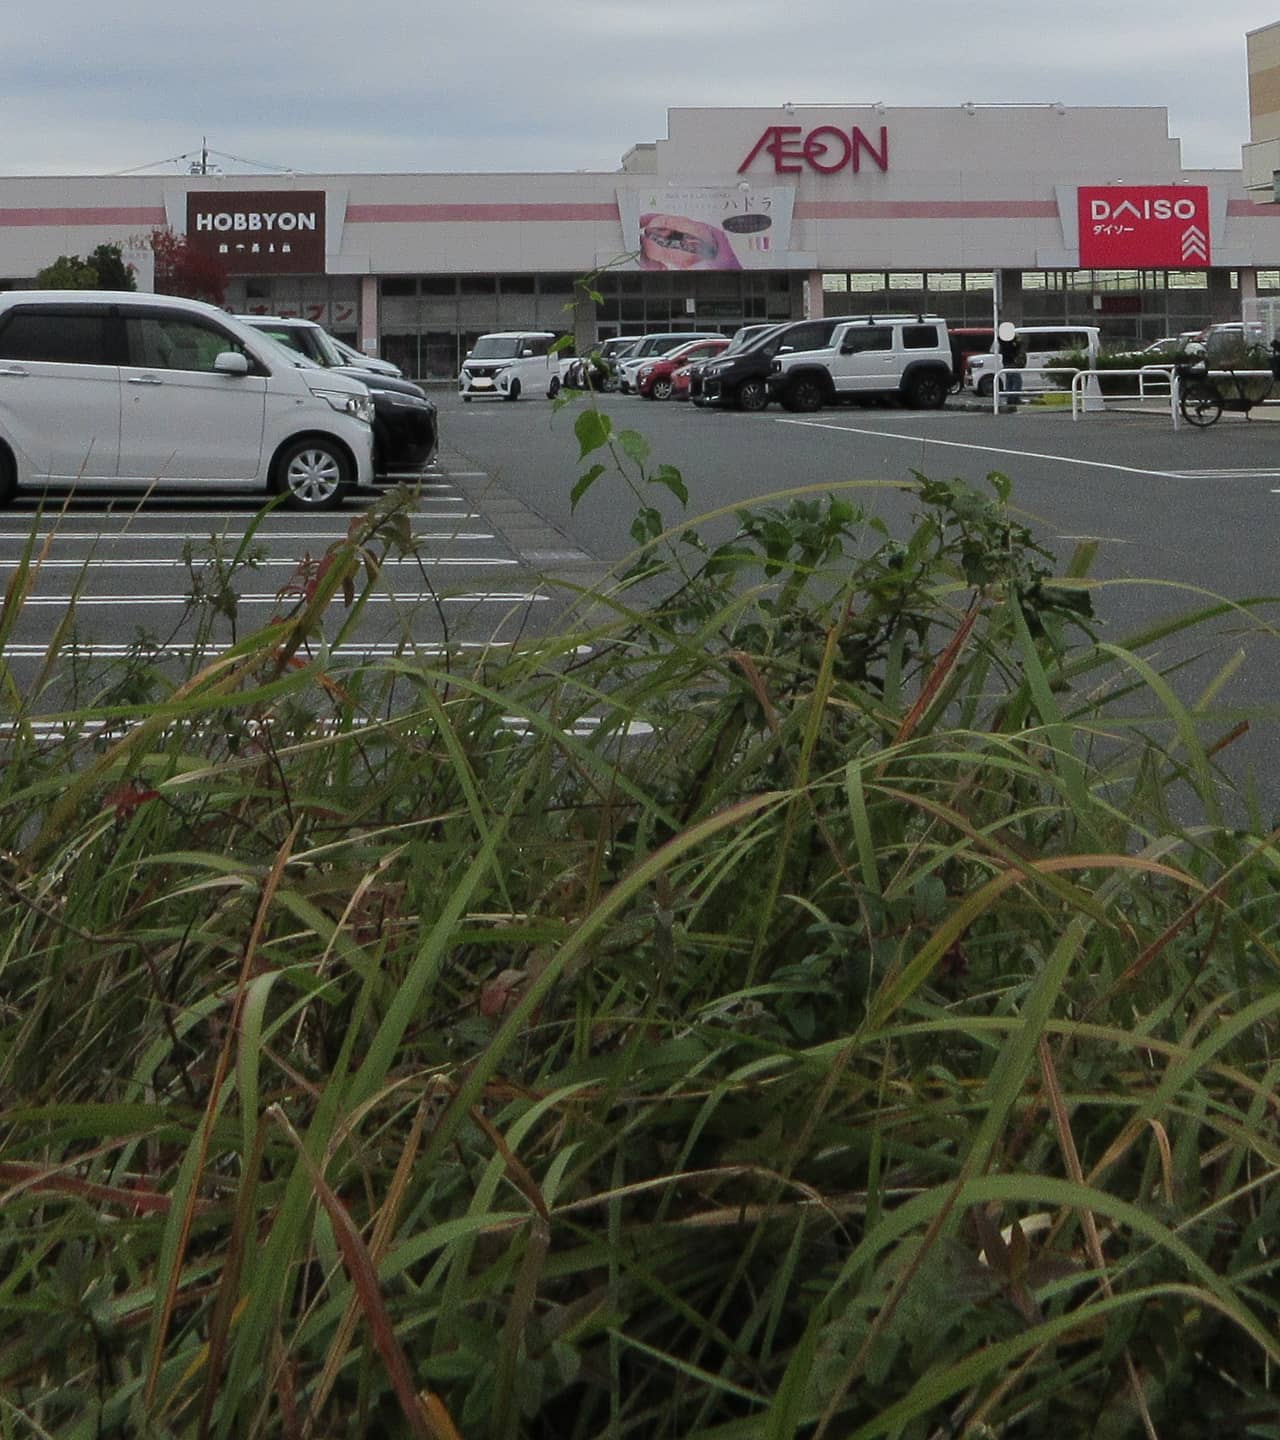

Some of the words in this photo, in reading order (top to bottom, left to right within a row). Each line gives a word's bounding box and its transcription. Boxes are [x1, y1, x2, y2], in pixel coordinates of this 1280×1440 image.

[1091, 199, 1196, 220] DAISO
[196, 212, 316, 231] HOBBYON
[1093, 224, 1135, 236] ダイソー
